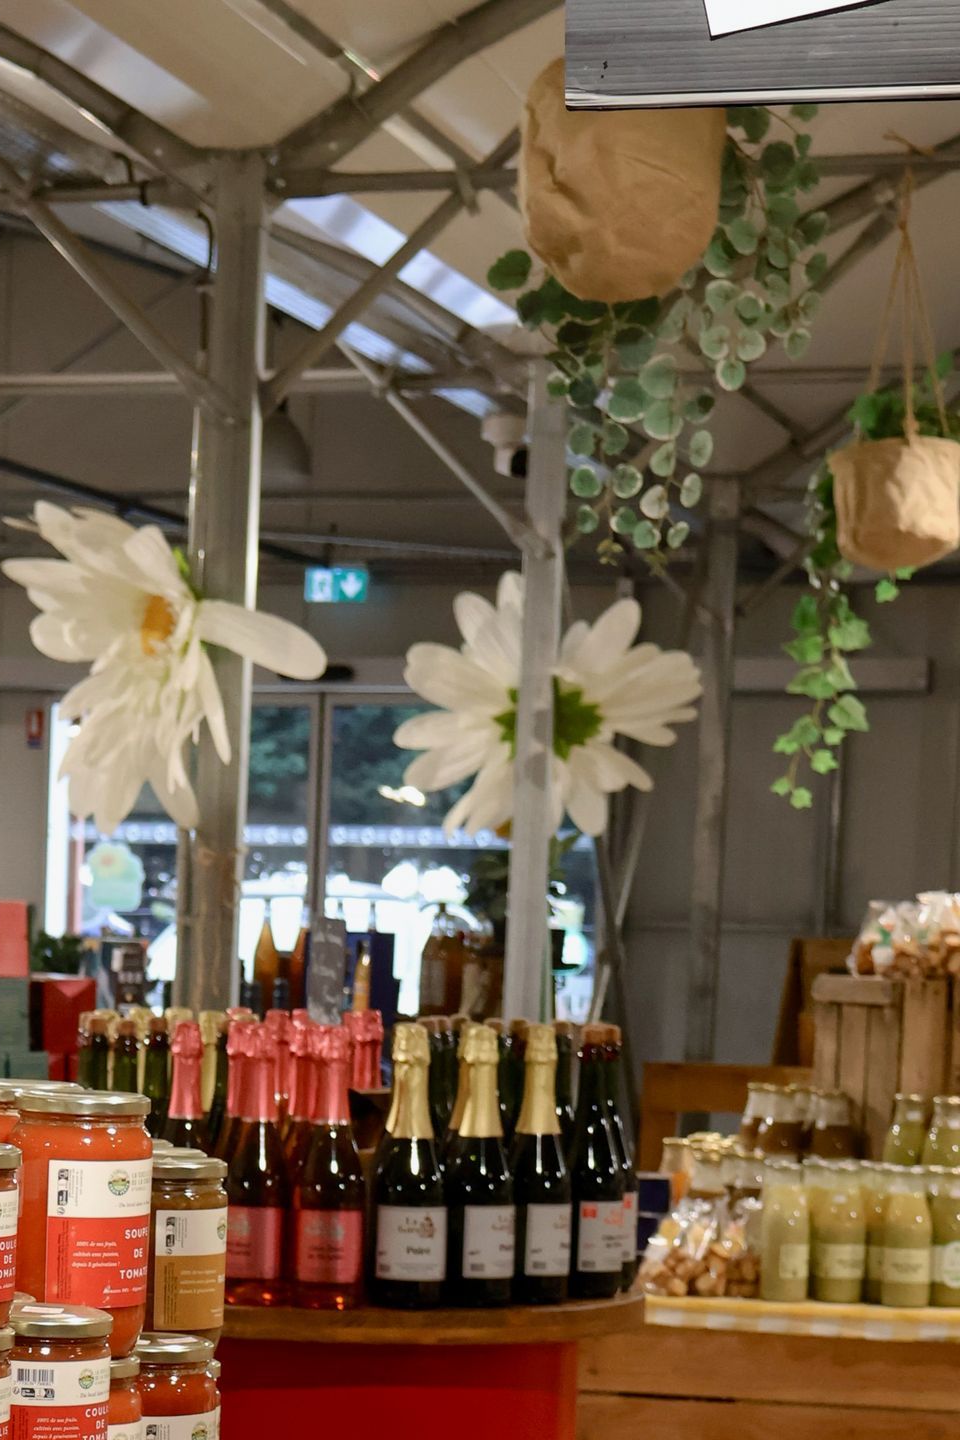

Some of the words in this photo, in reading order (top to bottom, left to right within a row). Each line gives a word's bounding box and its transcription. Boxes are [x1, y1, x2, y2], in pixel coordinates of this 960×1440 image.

[134, 1248, 143, 1258] DE
[4, 1255, 12, 1264] DE
[96, 1419, 105, 1429] DE
